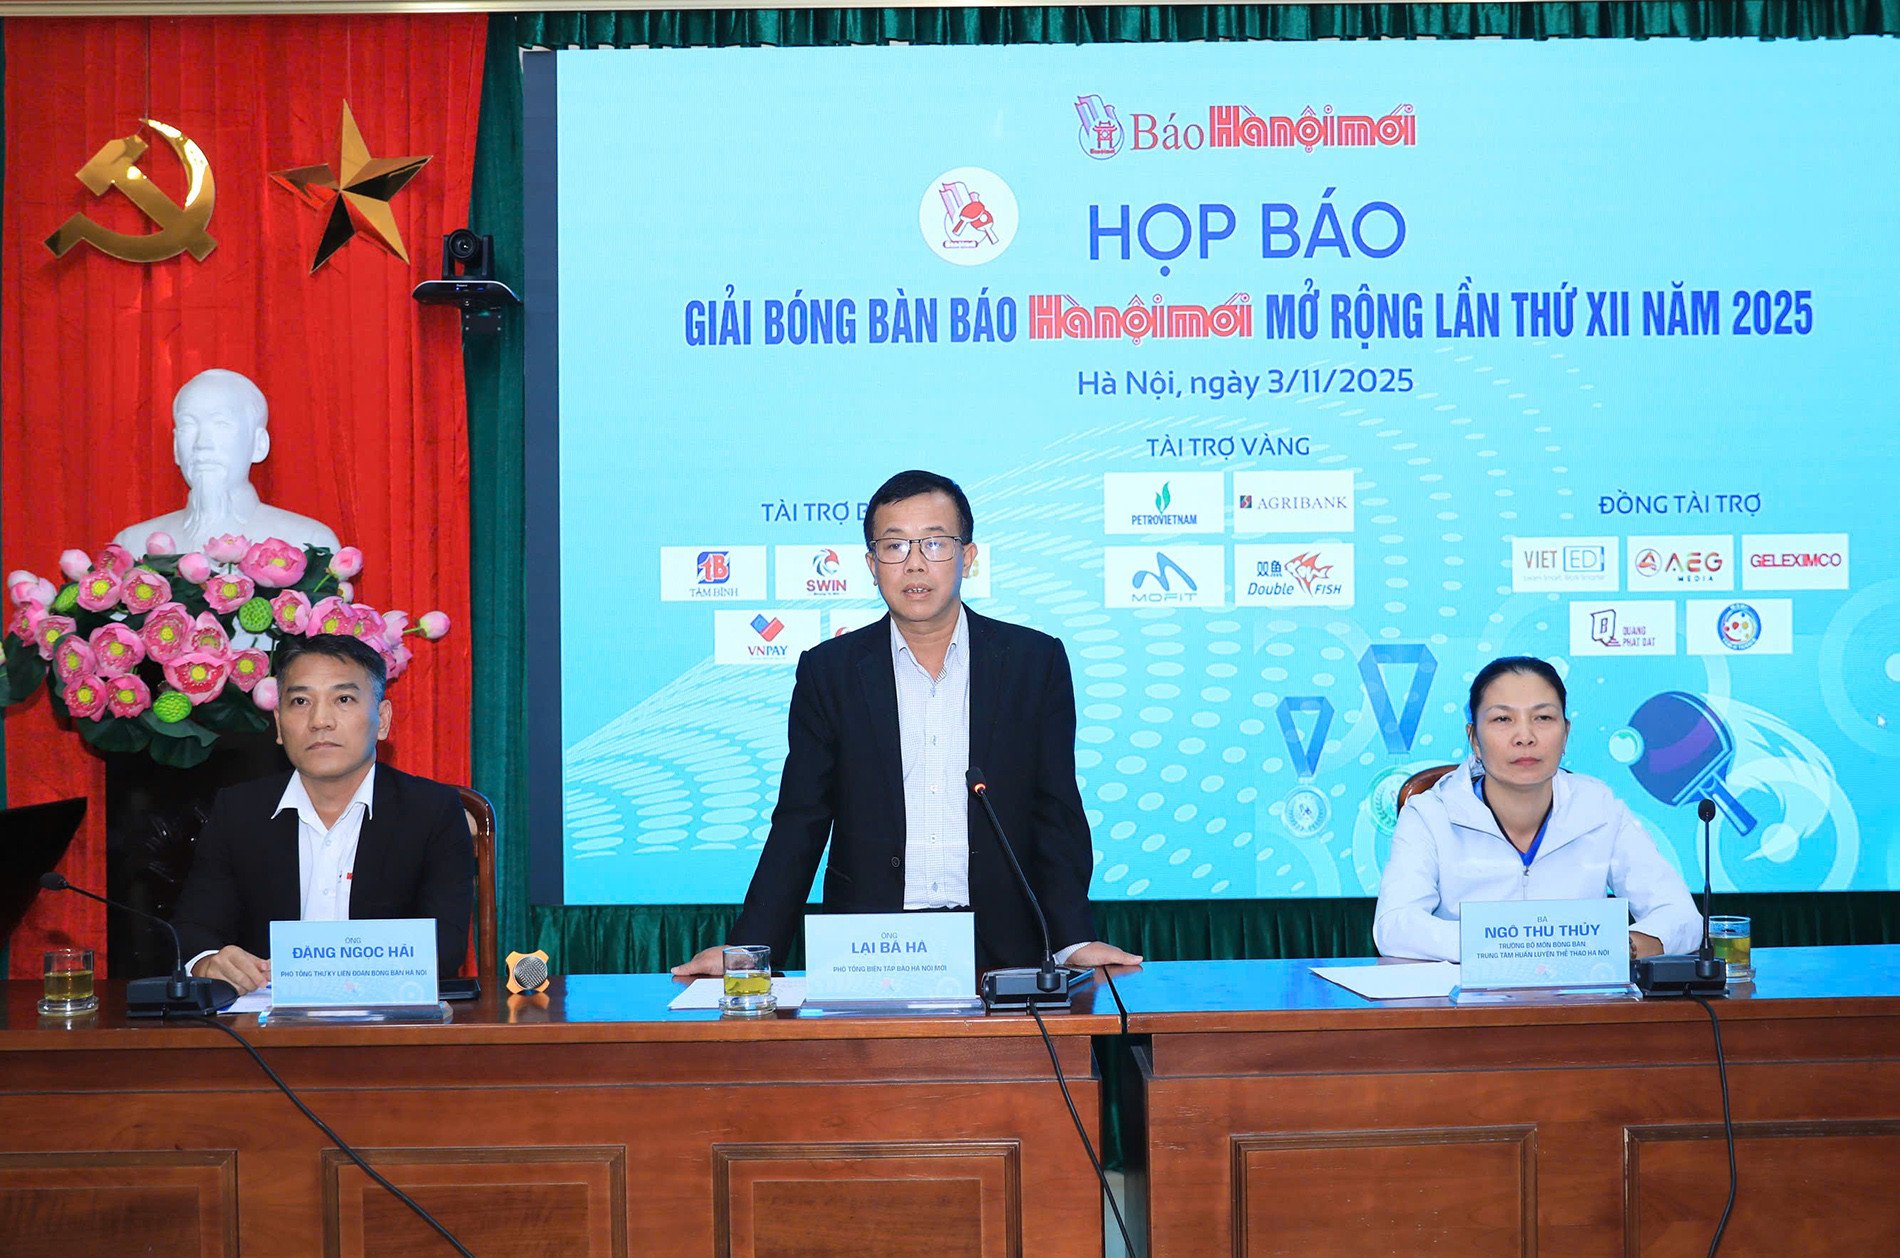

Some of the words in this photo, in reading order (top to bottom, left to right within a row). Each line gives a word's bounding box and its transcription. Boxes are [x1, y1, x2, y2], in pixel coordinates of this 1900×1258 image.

[1130, 112, 1204, 151] Báo
[1209, 103, 1416, 154] Hànộimới
[1089, 203, 1237, 277] HỌP
[1262, 186, 1406, 259] BÁO
[685, 284, 752, 346] GIẢI
[764, 289, 856, 345] BÓNG
[869, 288, 939, 344] BÀN
[950, 287, 1017, 343] BÁO
[1028, 292, 1252, 346] Hànộimới
[1266, 278, 1319, 340] MỞ
[1331, 284, 1423, 349] RỘNG
[1436, 276, 1500, 339] LẦN
[1511, 281, 1578, 337] THỨ
[1586, 290, 1630, 337] XII
[1643, 280, 1720, 336] NĂM
[1732, 289, 1813, 335] 2025
[1078, 370, 1116, 395] Hà
[1126, 370, 1181, 400] Nội,
[1190, 369, 1260, 400] ngày
[1268, 368, 1414, 394] 3/11/2025
[1146, 434, 1183, 457] TÀI
[1189, 436, 1235, 460] TRỢ
[1241, 433, 1310, 456] VÀNG
[761, 498, 797, 522] TÀI
[803, 501, 849, 525] TRỢ
[1257, 496, 1348, 510] AGRIBANK
[1598, 489, 1668, 514] ĐỒNG
[1673, 490, 1709, 514] TÀI
[1715, 492, 1761, 517] TRỢ
[1131, 514, 1198, 525] PETROVIETNAM
[1524, 550, 1557, 569] VIET
[1570, 549, 1597, 569] ED
[1665, 552, 1723, 572] AEG
[1750, 553, 1842, 567] GELEXIMCO
[806, 579, 847, 592] SWIN
[1247, 582, 1294, 596] Double
[1314, 583, 1342, 595] FISH
[1131, 593, 1198, 602] MOFIT
[747, 645, 789, 656] VNPAY
[1484, 925, 1519, 938] NGÔ
[1523, 925, 1554, 937] THU
[292, 944, 336, 961] ĐẶNG
[340, 946, 384, 960] NGỌC
[851, 941, 876, 956] LẠI
[880, 940, 901, 953] BÁ
